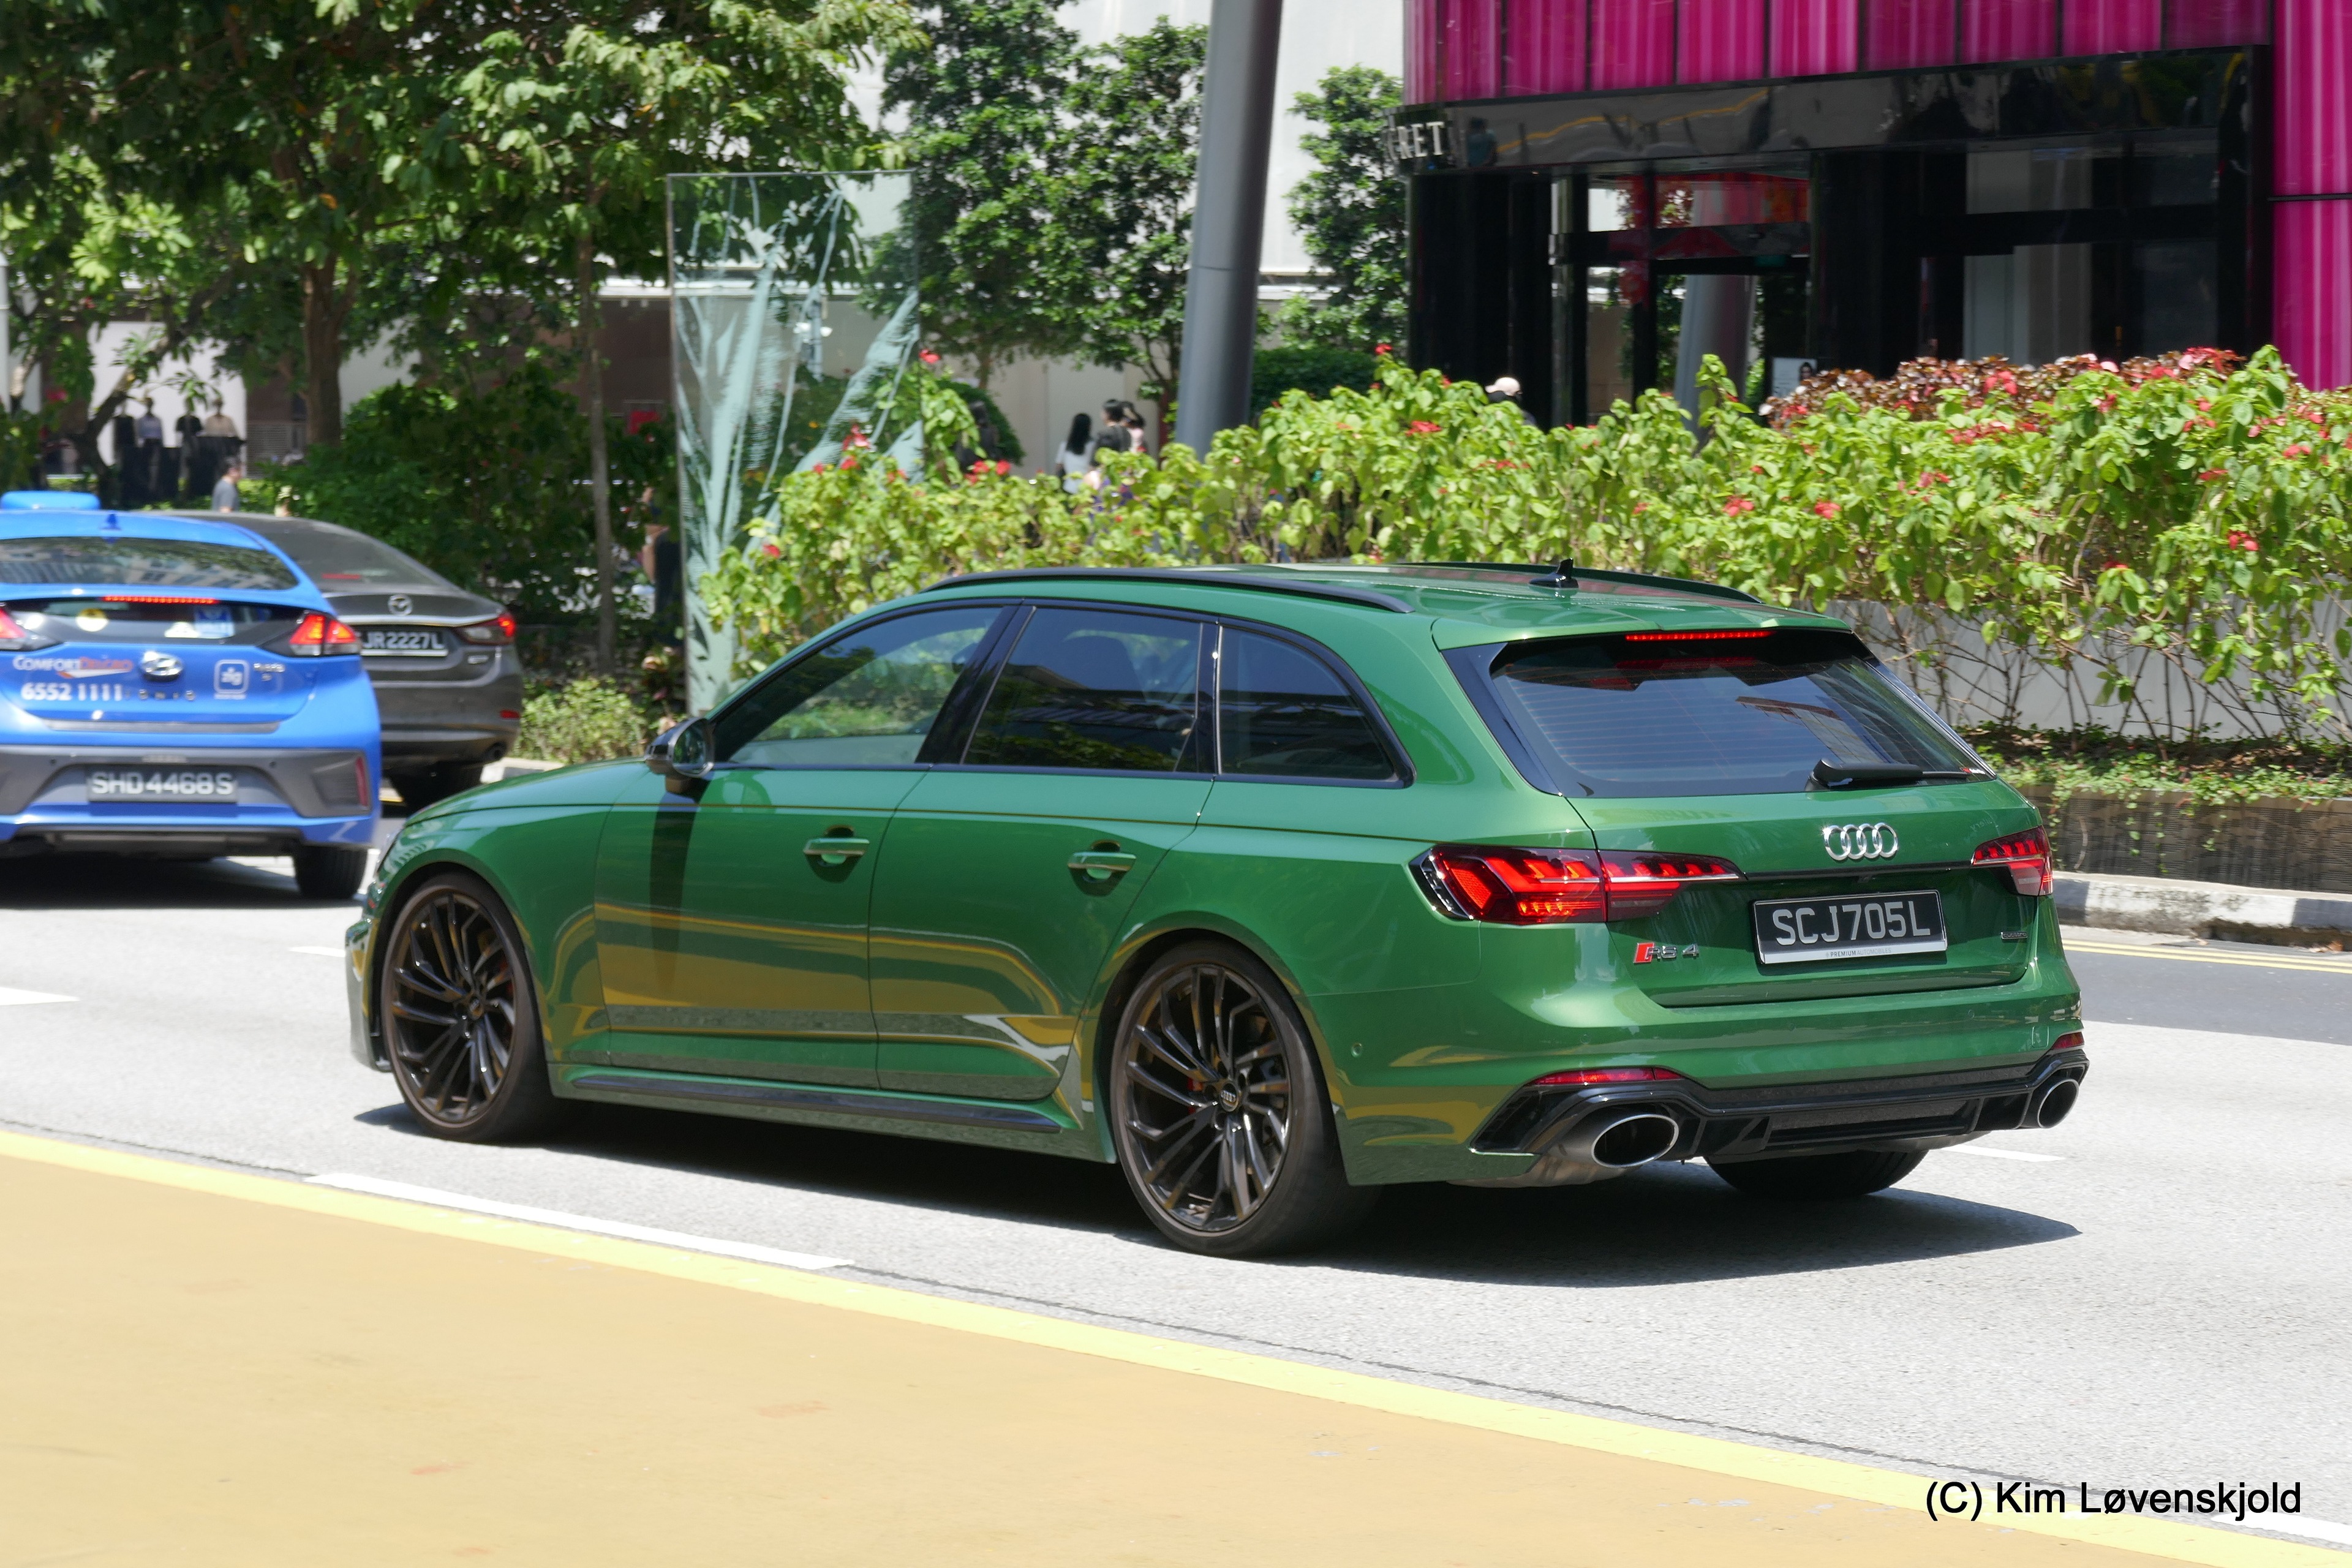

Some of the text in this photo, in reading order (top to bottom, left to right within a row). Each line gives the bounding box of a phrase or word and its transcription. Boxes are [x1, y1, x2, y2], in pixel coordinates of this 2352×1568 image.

[21, 682, 123, 701] 6552 1111
[1773, 901, 1931, 946] SCJ705L
